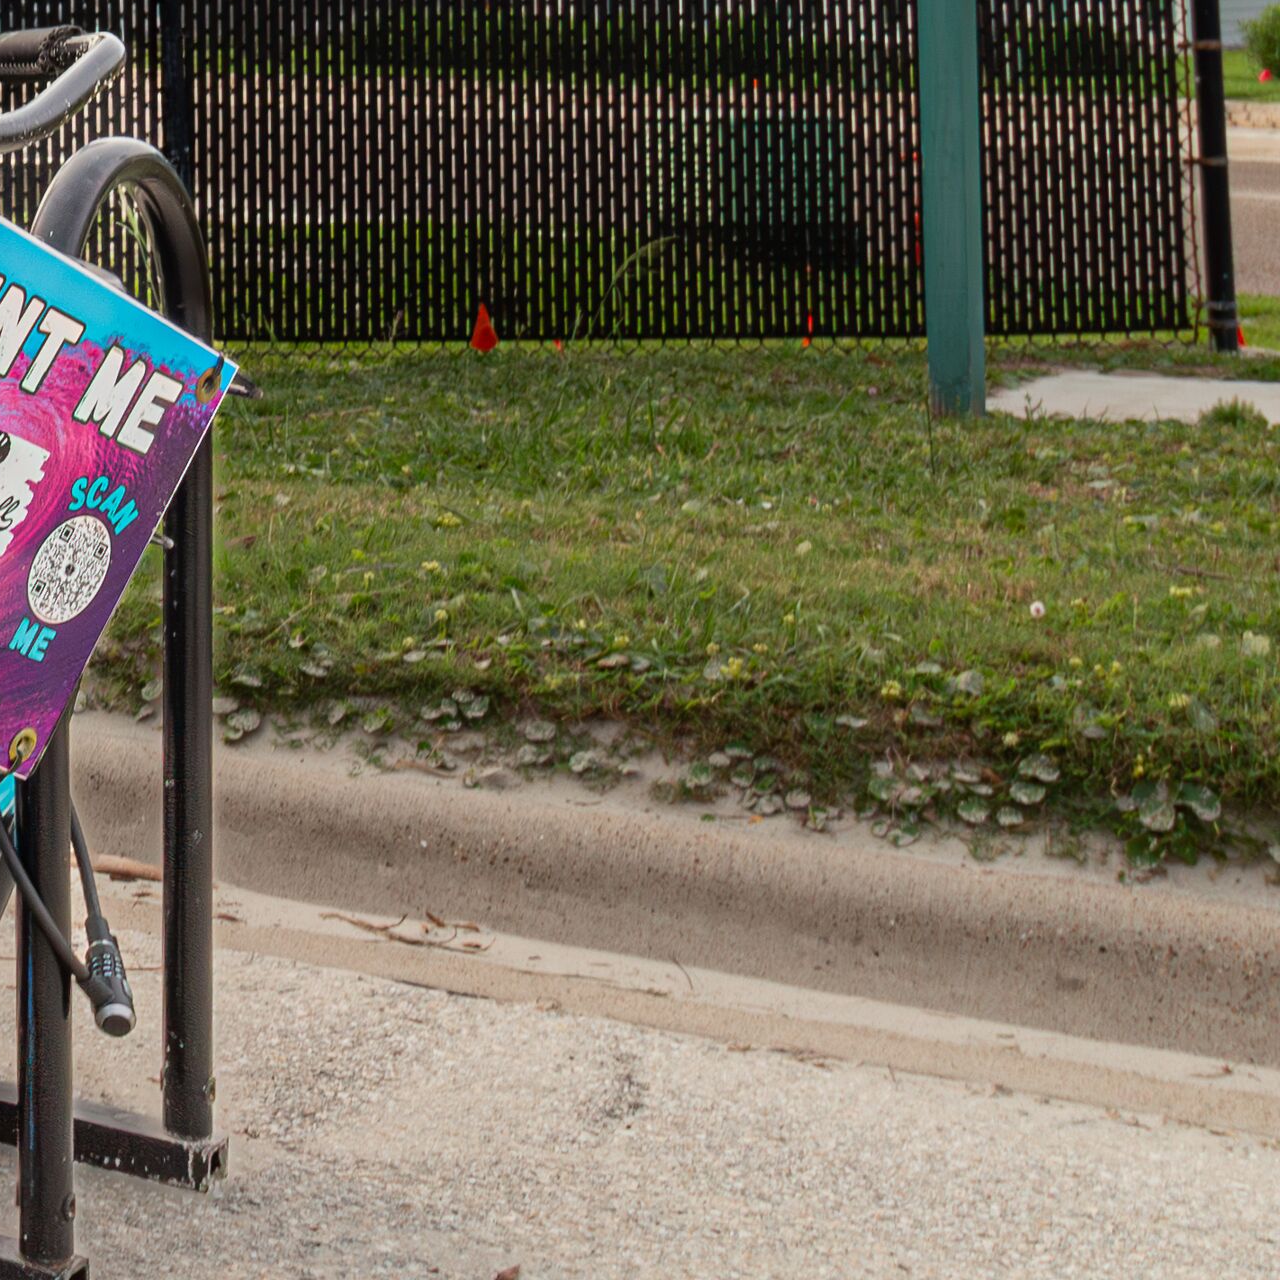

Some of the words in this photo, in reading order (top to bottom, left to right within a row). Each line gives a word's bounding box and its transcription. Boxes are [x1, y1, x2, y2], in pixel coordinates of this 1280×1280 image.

[73, 344, 183, 454] ME
[68, 476, 139, 535] SCAN
[8, 617, 57, 662] ME
